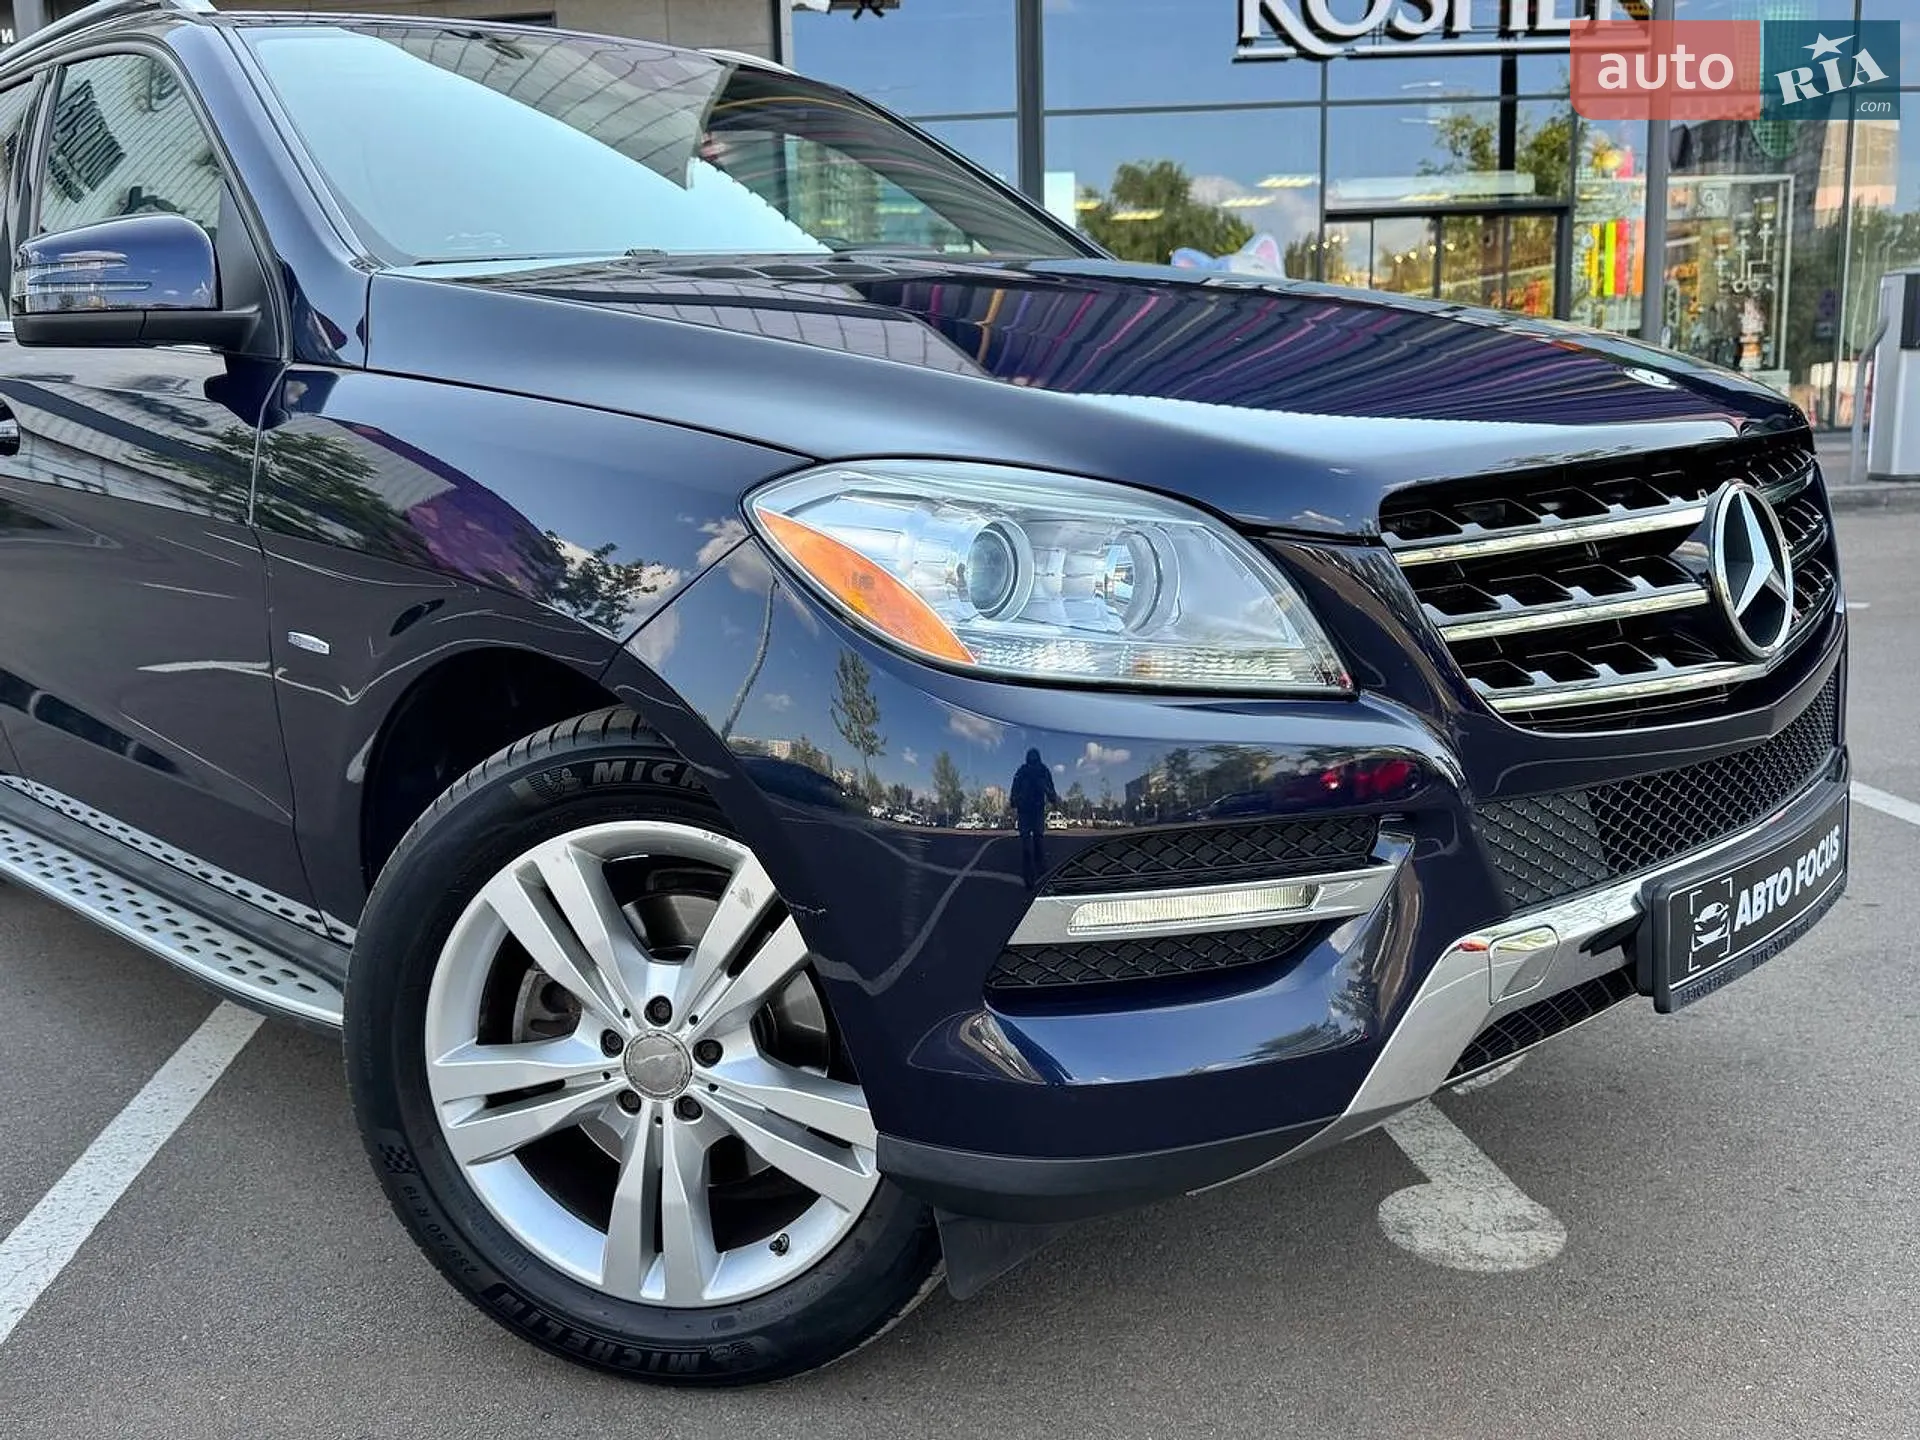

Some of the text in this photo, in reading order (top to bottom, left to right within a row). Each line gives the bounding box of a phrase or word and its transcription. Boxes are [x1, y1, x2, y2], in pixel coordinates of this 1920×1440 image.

[1734, 866, 1793, 932] АВТО
[1795, 824, 1840, 897] FOCUS
[495, 1291, 701, 1371] MICHELIN
